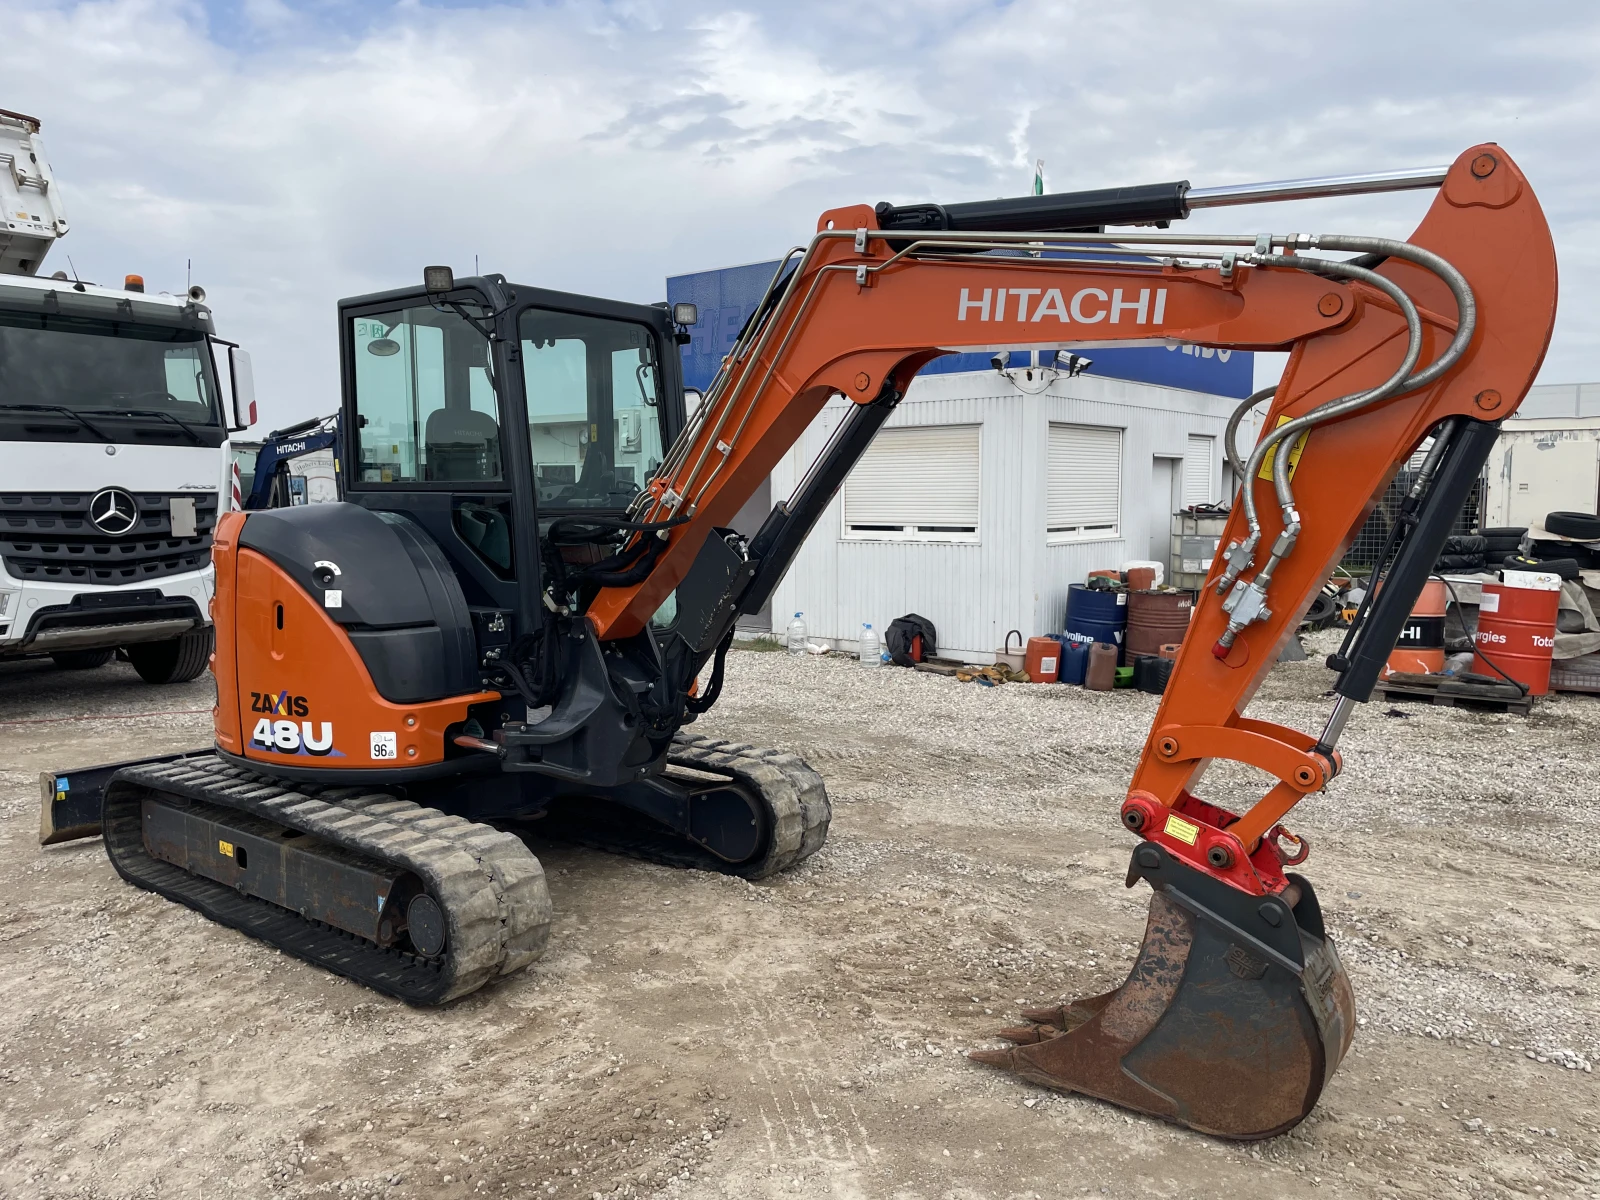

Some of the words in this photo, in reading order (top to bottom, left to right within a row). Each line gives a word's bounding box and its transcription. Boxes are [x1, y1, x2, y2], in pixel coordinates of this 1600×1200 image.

[958, 288, 1167, 324] HITACHI
[276, 442, 306, 454] HITACHI
[250, 690, 309, 717] ZAXIS
[252, 718, 333, 754] 48U
[373, 743, 388, 757] 96
